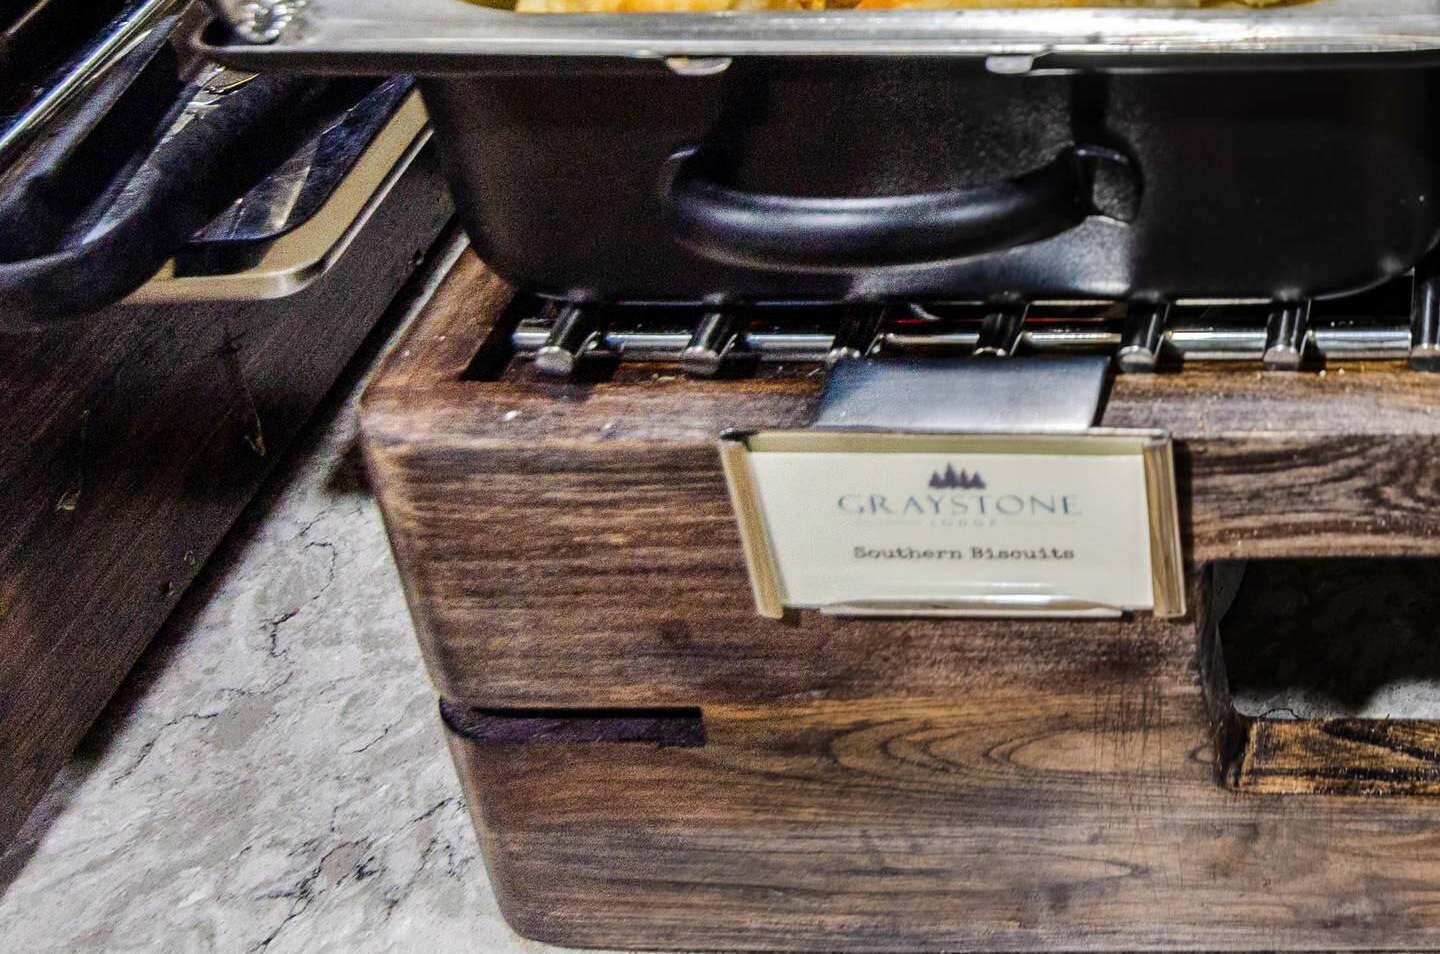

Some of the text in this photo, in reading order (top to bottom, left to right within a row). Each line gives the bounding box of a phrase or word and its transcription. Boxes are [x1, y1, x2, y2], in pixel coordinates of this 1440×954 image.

[837, 494, 1082, 516] GRAYSTONE
[853, 546, 1075, 560] Southern Biscuits
